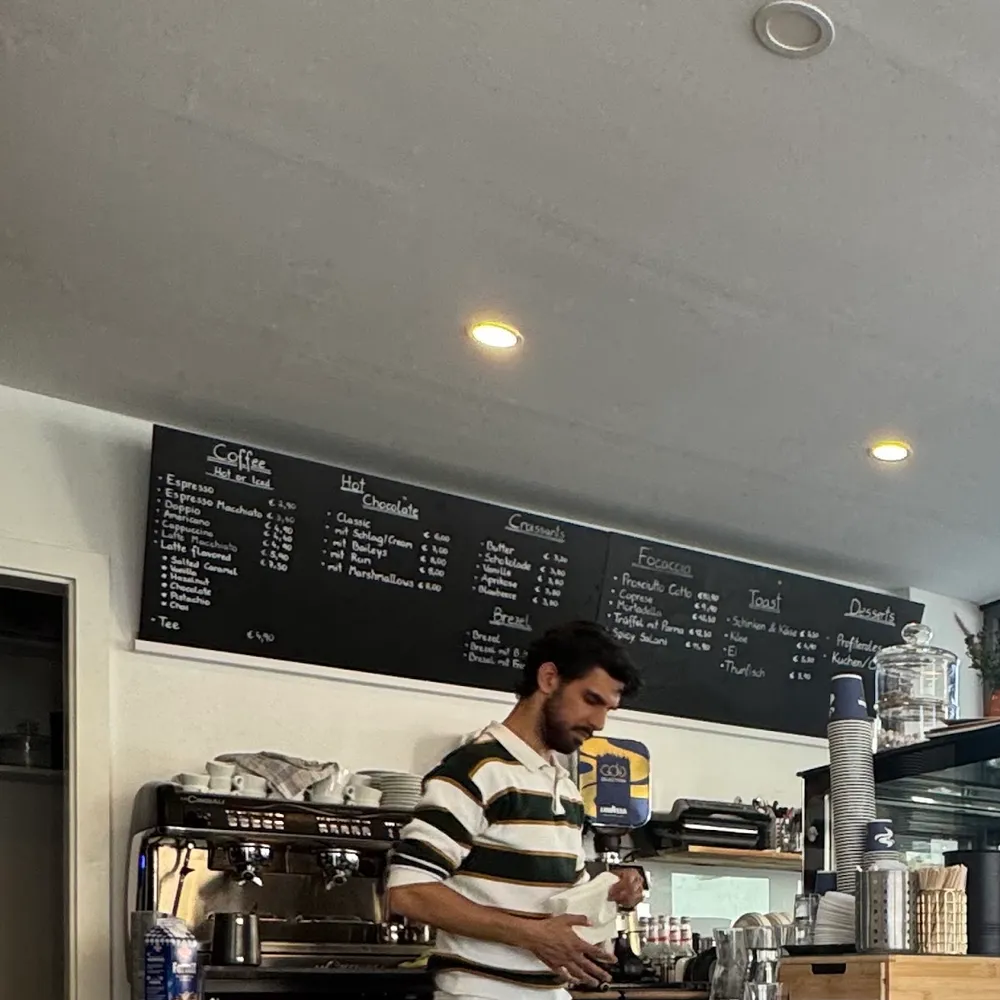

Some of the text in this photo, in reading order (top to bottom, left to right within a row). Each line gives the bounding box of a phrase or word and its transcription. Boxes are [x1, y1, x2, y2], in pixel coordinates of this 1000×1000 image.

[213, 443, 266, 472] Coffee
[166, 473, 214, 494] Espresso
[214, 466, 270, 488] Hot or Iced
[341, 474, 366, 491] Hot
[164, 499, 201, 516] Doppio
[165, 488, 214, 506] Espresso
[217, 500, 263, 519] Macchiato
[362, 493, 419, 516] Chocolate
[163, 510, 211, 527] Americano
[336, 511, 371, 529] Classic
[162, 519, 214, 538] Cappuccino
[334, 526, 349, 536] mit
[160, 540, 187, 554] Latte
[161, 529, 185, 542] Latte
[191, 535, 238, 553] Macchiato
[332, 538, 347, 548] mit
[351, 540, 388, 559] Baileys
[486, 540, 515, 555] Butter
[170, 555, 239, 577] Salted Caramel
[330, 550, 345, 560] mit
[350, 552, 372, 565] Rum
[484, 552, 532, 571] Schokolade
[637, 545, 692, 574] Focaccia
[170, 572, 210, 586] Hazelnut
[327, 562, 342, 572] mit
[348, 565, 415, 588] Marshmallows
[169, 581, 212, 596] Chocolate
[621, 571, 665, 593] Prosciutto
[668, 583, 693, 599] Cotto
[169, 600, 189, 612] Chai
[170, 591, 211, 606] Pistachio
[619, 588, 654, 605] Caprese
[748, 588, 782, 612] Toast
[492, 606, 530, 626] Brezel
[616, 599, 663, 618] Mortadella
[850, 598, 896, 622] Desserts
[158, 615, 180, 631] Tee
[661, 619, 685, 635] Parma
[768, 621, 776, 633] &
[471, 629, 501, 644] Brezel
[612, 627, 636, 644] Spicy
[724, 659, 766, 678] Thunfisch
[831, 650, 877, 671] Kuchen/C
